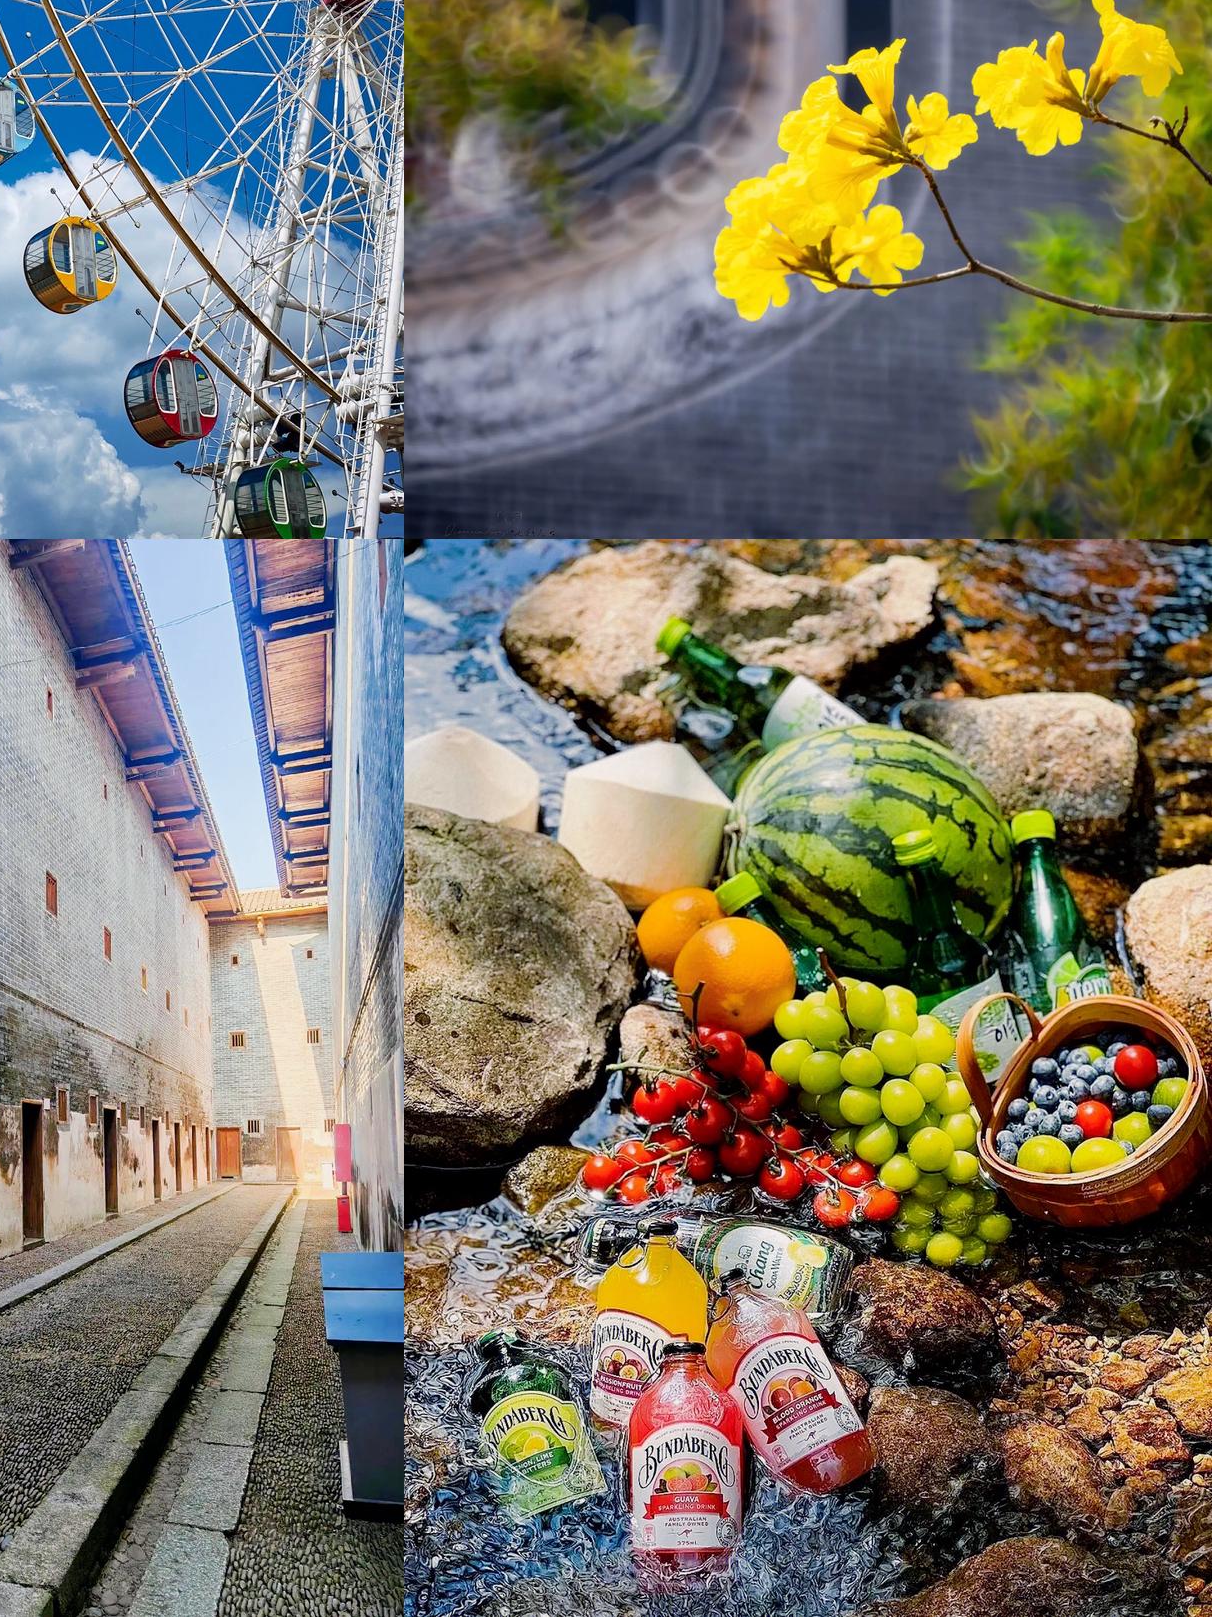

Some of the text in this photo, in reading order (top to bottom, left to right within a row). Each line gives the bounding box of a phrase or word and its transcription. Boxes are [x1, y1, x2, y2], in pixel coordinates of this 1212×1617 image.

[593, 1322, 665, 1372] BUNDABERG
[739, 1346, 832, 1420] BUNDABERG
[772, 1393, 824, 1424] BLOOD ORANGE
[536, 1451, 554, 1463] LIME
[638, 1432, 736, 1489] BUNDABERG
[658, 1503, 695, 1511] SPARKLING
